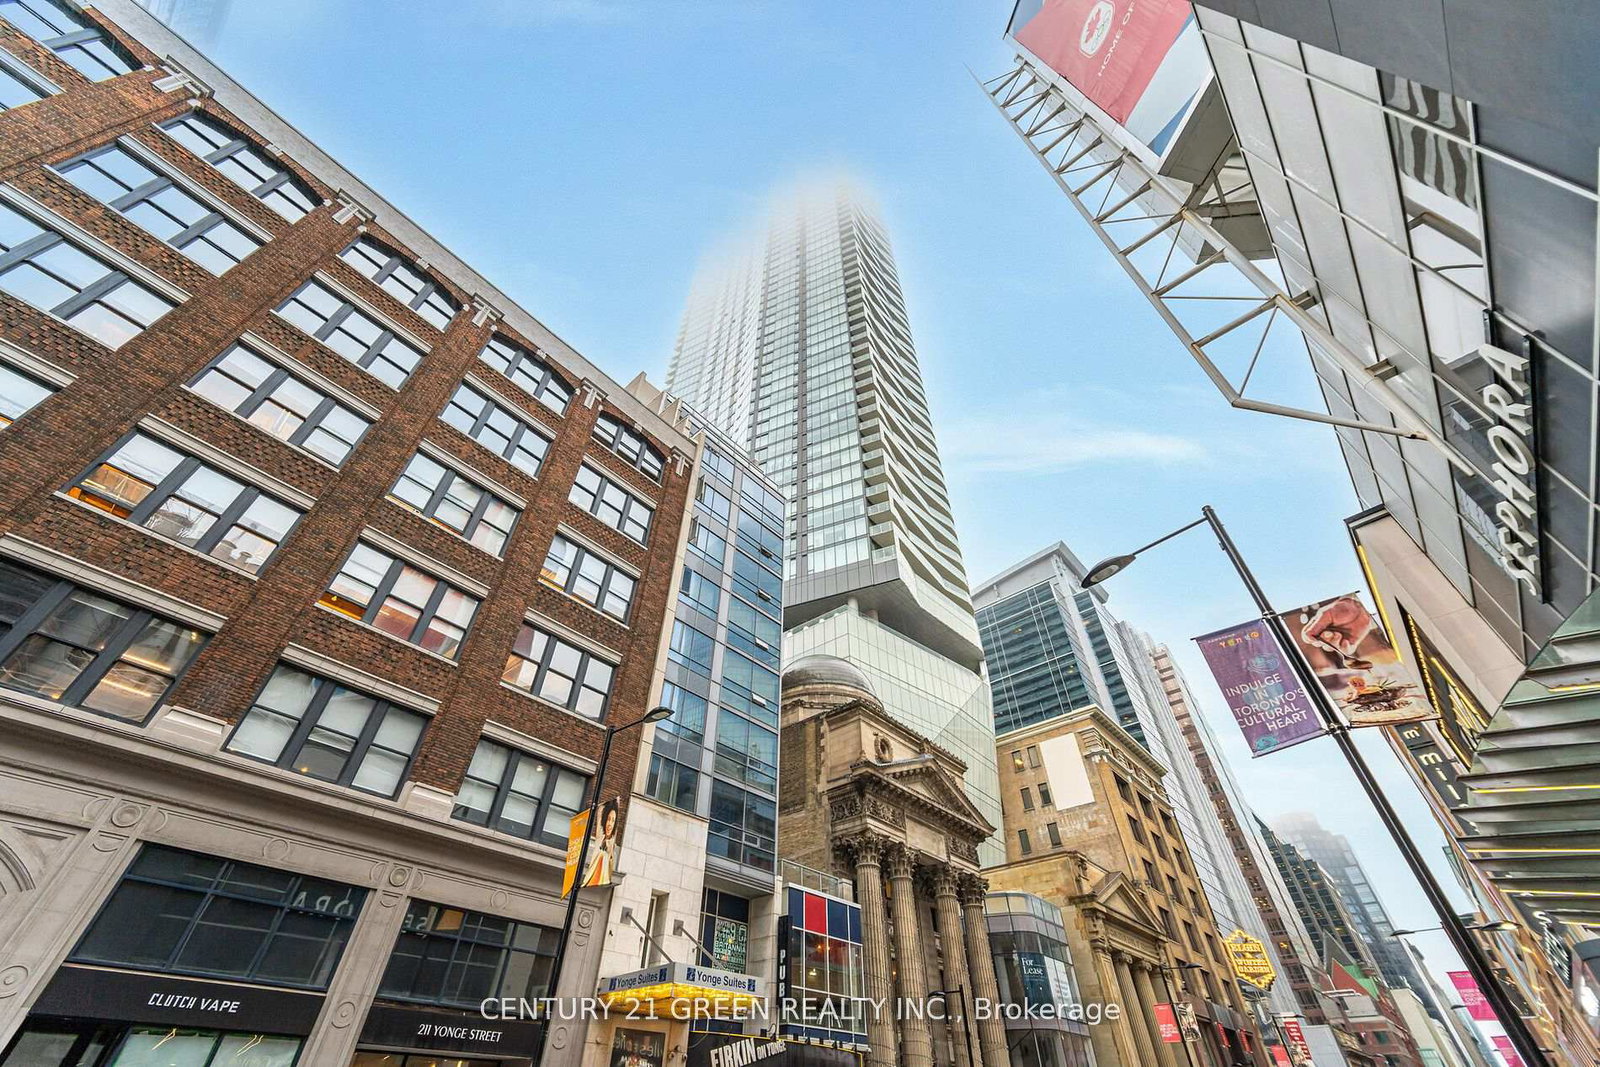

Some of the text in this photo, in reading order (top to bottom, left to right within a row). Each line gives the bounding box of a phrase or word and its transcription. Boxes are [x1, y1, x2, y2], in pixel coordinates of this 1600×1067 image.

[1097, 29, 1123, 77] HOME
[1479, 343, 1542, 596] SEPHORA
[1226, 673, 1282, 697] INDULGE
[1253, 689, 1269, 701] IN
[1234, 688, 1306, 717] TORONTO'S
[1238, 703, 1300, 728] CULTURAL
[1266, 710, 1308, 732] HEART
[1021, 957, 1034, 966] For
[1023, 965, 1044, 975] Lease
[617, 972, 658, 988] Yonge Suites
[697, 971, 747, 989] Yonge Suites
[147, 992, 240, 1013] CLUTCH VAPE
[417, 1023, 503, 1042] 211 YONGE STREET
[710, 1037, 757, 1067] FIRKIN
